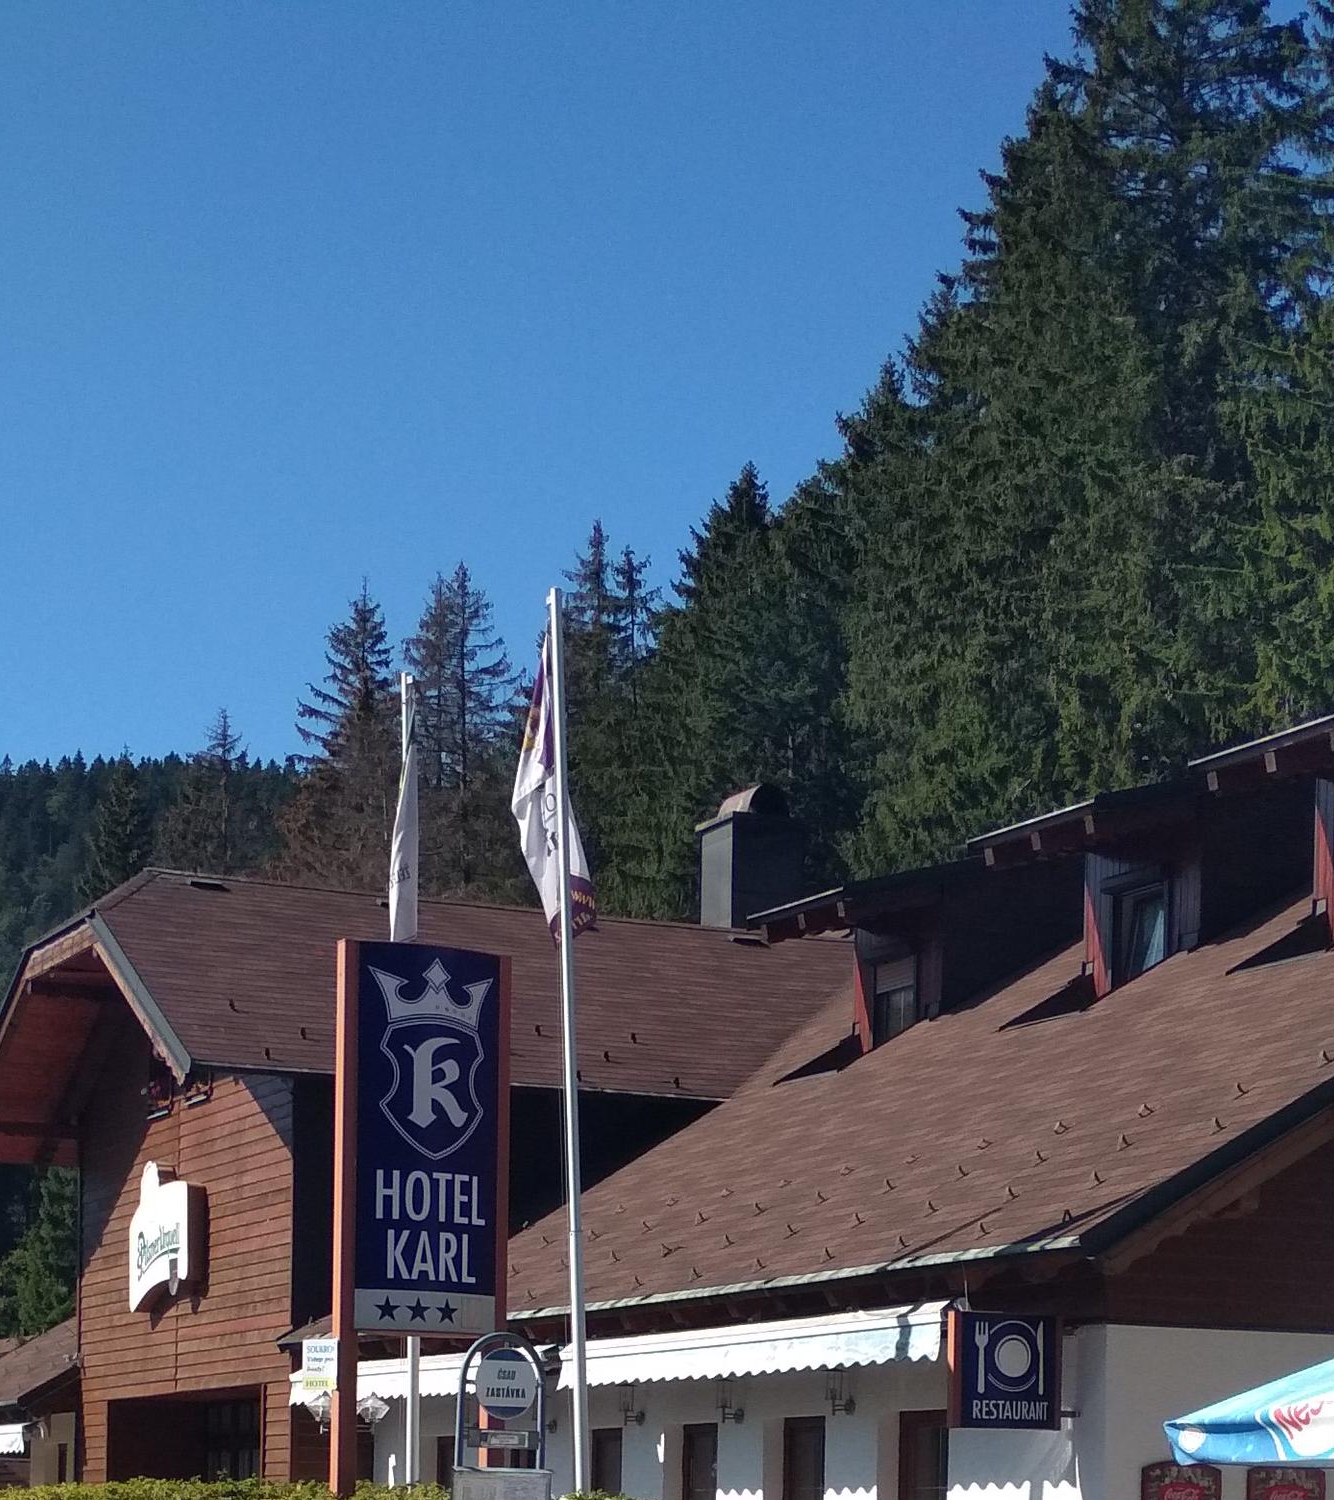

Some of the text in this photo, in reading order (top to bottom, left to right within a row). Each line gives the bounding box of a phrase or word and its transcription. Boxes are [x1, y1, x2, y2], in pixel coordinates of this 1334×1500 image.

[375, 1168, 486, 1226] HOTEL
[386, 1229, 476, 1284] KARL
[486, 1386, 526, 1399] ZASTÁVKA
[972, 1400, 1048, 1420] RESTAURANT
